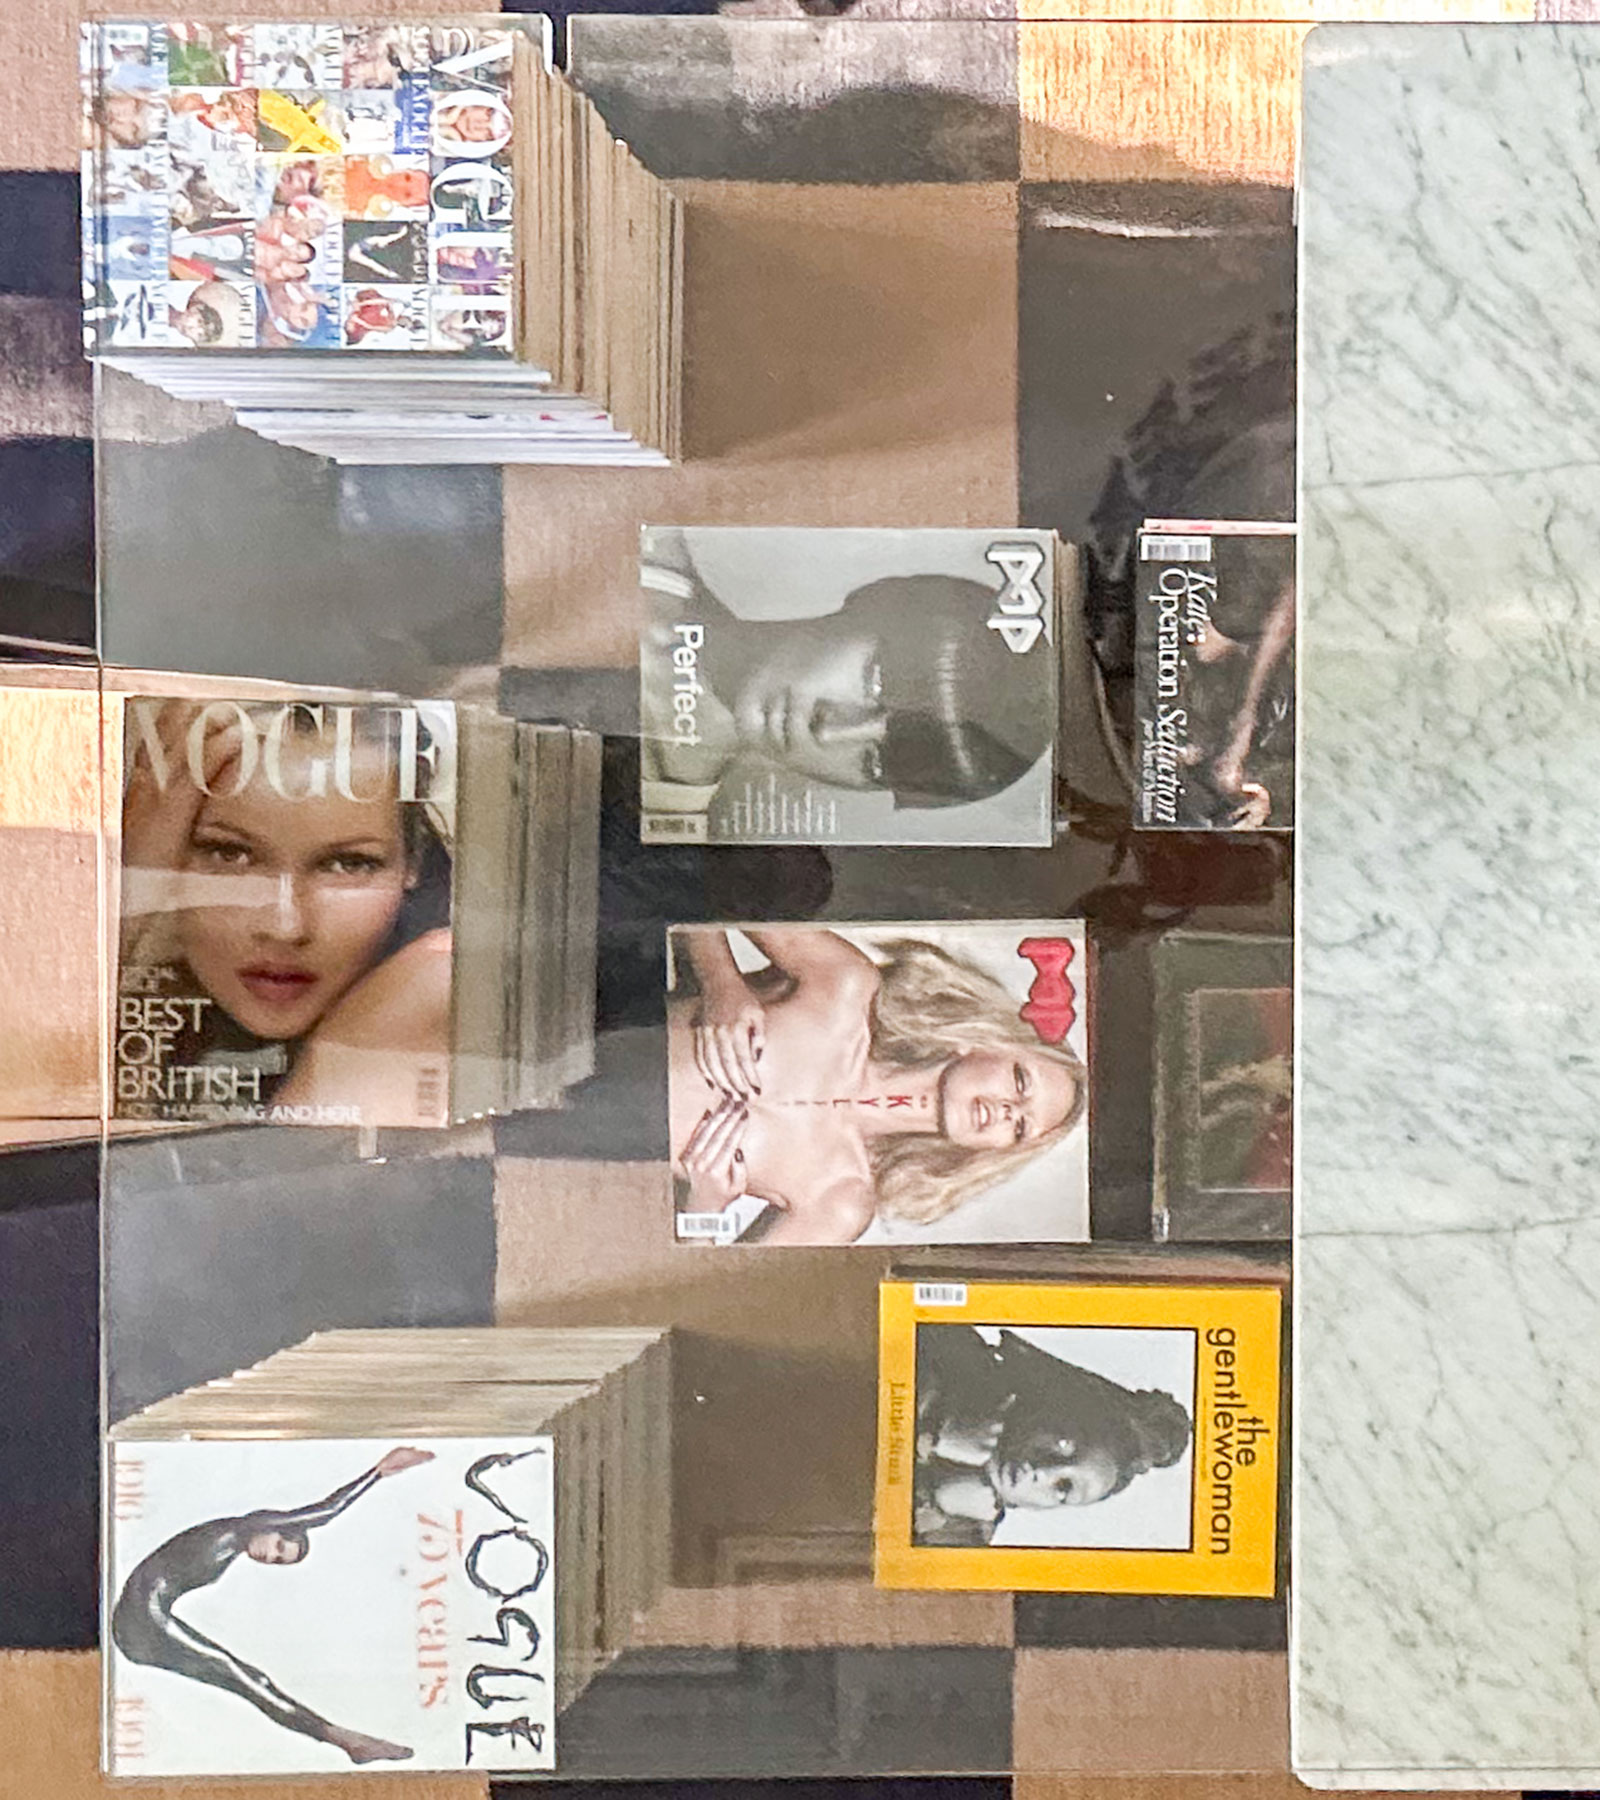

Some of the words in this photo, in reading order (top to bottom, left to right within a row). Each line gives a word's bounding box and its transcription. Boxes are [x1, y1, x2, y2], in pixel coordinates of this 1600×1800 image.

[429, 31, 512, 350] VOGUE
[1181, 568, 1217, 645] Kate:
[673, 622, 704, 746] Perfect
[133, 702, 455, 803] VOGUE
[117, 1031, 175, 1066] OF
[119, 997, 211, 1032] BEST
[118, 1065, 261, 1102] BRITISH
[271, 1104, 312, 1121] AND
[1206, 1327, 1246, 1555] gentlewoman
[1236, 1417, 1270, 1466] the
[417, 1569, 452, 1709] years
[465, 1448, 548, 1766] VOGUE
